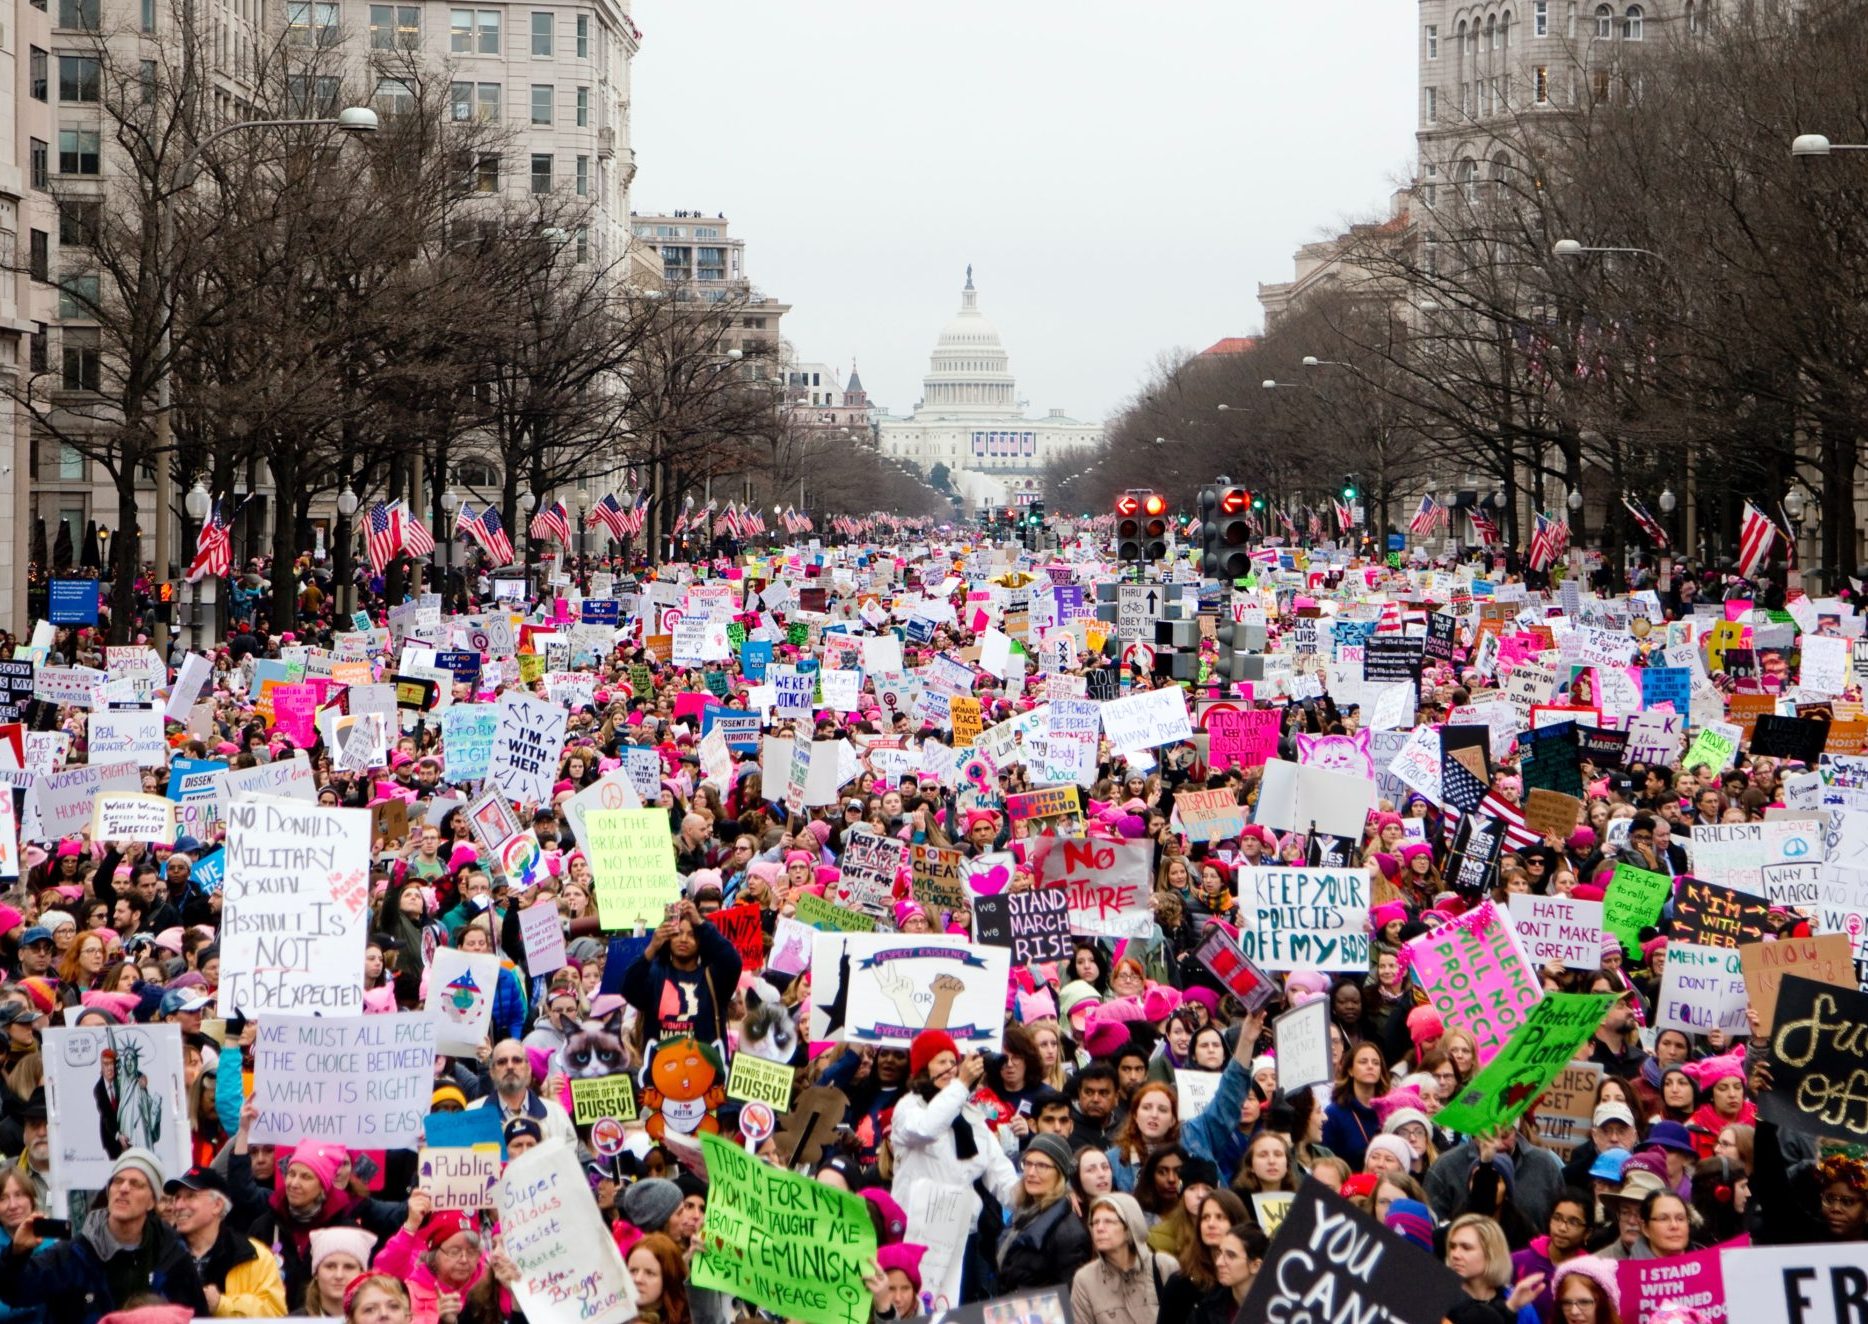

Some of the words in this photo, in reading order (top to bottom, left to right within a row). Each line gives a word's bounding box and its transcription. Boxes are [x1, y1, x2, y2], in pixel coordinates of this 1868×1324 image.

[1121, 589, 1141, 597] THRU
[1120, 618, 1140, 626] OBEY
[1294, 631, 1316, 642] LIVES
[1590, 628, 1629, 644] TRUMP
[108, 648, 144, 658] NASTY
[1584, 650, 1626, 668] TREASON
[1672, 650, 1694, 662] YES
[109, 659, 148, 670] WOMEN
[14, 680, 32, 690] MY
[776, 675, 804, 689] WE'RE
[1512, 668, 1555, 684] ABORTION
[1524, 684, 1536, 693] ON
[956, 714, 978, 724] PLACE
[1237, 712, 1254, 726] MY
[1256, 711, 1280, 725] BODY
[95, 727, 118, 739] REAL
[520, 727, 542, 745] I'M
[508, 738, 547, 762] WITH
[1588, 740, 1623, 750] MARCH
[1050, 744, 1074, 767] Body
[510, 755, 540, 775] HER
[46, 769, 96, 791] WOMEN'S
[100, 762, 140, 780] RIGHTS
[1036, 802, 1076, 814] STAND
[1177, 790, 1235, 812] DISPUTIN
[230, 806, 256, 829] NO
[598, 817, 617, 830] ON
[622, 817, 650, 830] THE
[1197, 811, 1217, 822] THIS
[850, 830, 875, 848] KEEP
[1694, 826, 1761, 842] RACISM
[1778, 821, 1815, 832] LOVE
[226, 832, 335, 871] MILITARY
[591, 835, 632, 850] BRIGHT
[640, 835, 666, 848] SIDE
[1467, 844, 1489, 855] LOVE
[604, 856, 622, 869] NO
[629, 855, 663, 869] MORE
[1063, 842, 1116, 874] NO
[1461, 857, 1485, 873] NO
[842, 865, 862, 878] OUT
[1624, 870, 1641, 884] It's
[1644, 877, 1660, 890] fun
[1768, 868, 1801, 883] WHY
[596, 875, 642, 890] GRIZZLY
[927, 880, 962, 895] PUBLIC
[1255, 873, 1309, 905] KEEP
[1312, 873, 1365, 908] YOUR
[914, 891, 962, 908] SCHOOLS
[978, 902, 996, 912] we
[1008, 890, 1066, 915] STAND
[1616, 885, 1626, 893] to
[1626, 888, 1649, 902] rally
[601, 897, 613, 910] IN
[810, 897, 827, 909] OUR
[832, 904, 873, 927] CLIMATE
[1533, 902, 1574, 921] HATE
[1614, 901, 1632, 910] and
[1707, 896, 1741, 918] I'M
[803, 903, 837, 924] CANNOT
[1257, 906, 1345, 929] POLICIES
[1606, 911, 1620, 922] for
[983, 928, 999, 938] we
[1010, 914, 1069, 937] MARCH
[1701, 914, 1741, 936] WITH
[1559, 925, 1600, 944] MAKE
[1698, 931, 1737, 949] HER
[255, 936, 318, 972] NOT
[1015, 935, 1074, 961] RISE
[1243, 931, 1283, 961] OFF
[1290, 934, 1337, 964] MY
[1535, 942, 1592, 962] GREAT!
[1761, 942, 1817, 967] NOW
[1668, 949, 1704, 965] MEN
[1679, 976, 1719, 990] DON'T
[914, 993, 932, 1003] OR
[1434, 943, 1499, 1048] PROTECT
[259, 1025, 288, 1044] WE
[298, 1026, 348, 1047] MUST
[354, 1026, 385, 1046] ALL
[394, 1022, 434, 1043] FACE
[874, 1025, 912, 1038] EXPECT
[259, 1051, 297, 1071] THE
[305, 1053, 360, 1073] CHOICE
[367, 1048, 433, 1072] BETWEEN
[734, 1065, 760, 1079] HANDS
[762, 1071, 776, 1082] OFF
[266, 1080, 327, 1104] WHAT
[338, 1082, 358, 1103] IS
[366, 1076, 422, 1102] RIGHT
[575, 1088, 600, 1100] HANDS
[601, 1088, 616, 1098] OFF
[618, 1086, 630, 1096] MY
[731, 1074, 788, 1107] PUSSY!
[577, 1098, 633, 1120] PUSSY!
[254, 1112, 294, 1134] AND
[299, 1114, 347, 1134] WHAT
[358, 1114, 376, 1134] IS
[384, 1108, 428, 1133] EASY
[1534, 1117, 1576, 1140] STUFF
[435, 1155, 494, 1176] Public
[703, 1139, 747, 1182] THIS
[751, 1162, 763, 1196] IS
[768, 1177, 808, 1210] FOR
[811, 1185, 844, 1219] MY
[504, 1172, 558, 1210] Super
[712, 1174, 742, 1213] MOM
[744, 1191, 764, 1225] WHO
[764, 1209, 818, 1238] TAUGHT
[828, 1220, 861, 1244] ME
[506, 1219, 560, 1258] Fascist
[706, 1207, 743, 1241] ABOUT
[747, 1226, 867, 1286] FEMINISM
[1309, 1200, 1385, 1282] YOU
[698, 1252, 743, 1286] REST
[775, 1284, 828, 1310] PEACE
[1640, 1269, 1646, 1282] I
[1651, 1262, 1702, 1280] STAND
[1641, 1281, 1684, 1296] WITH
